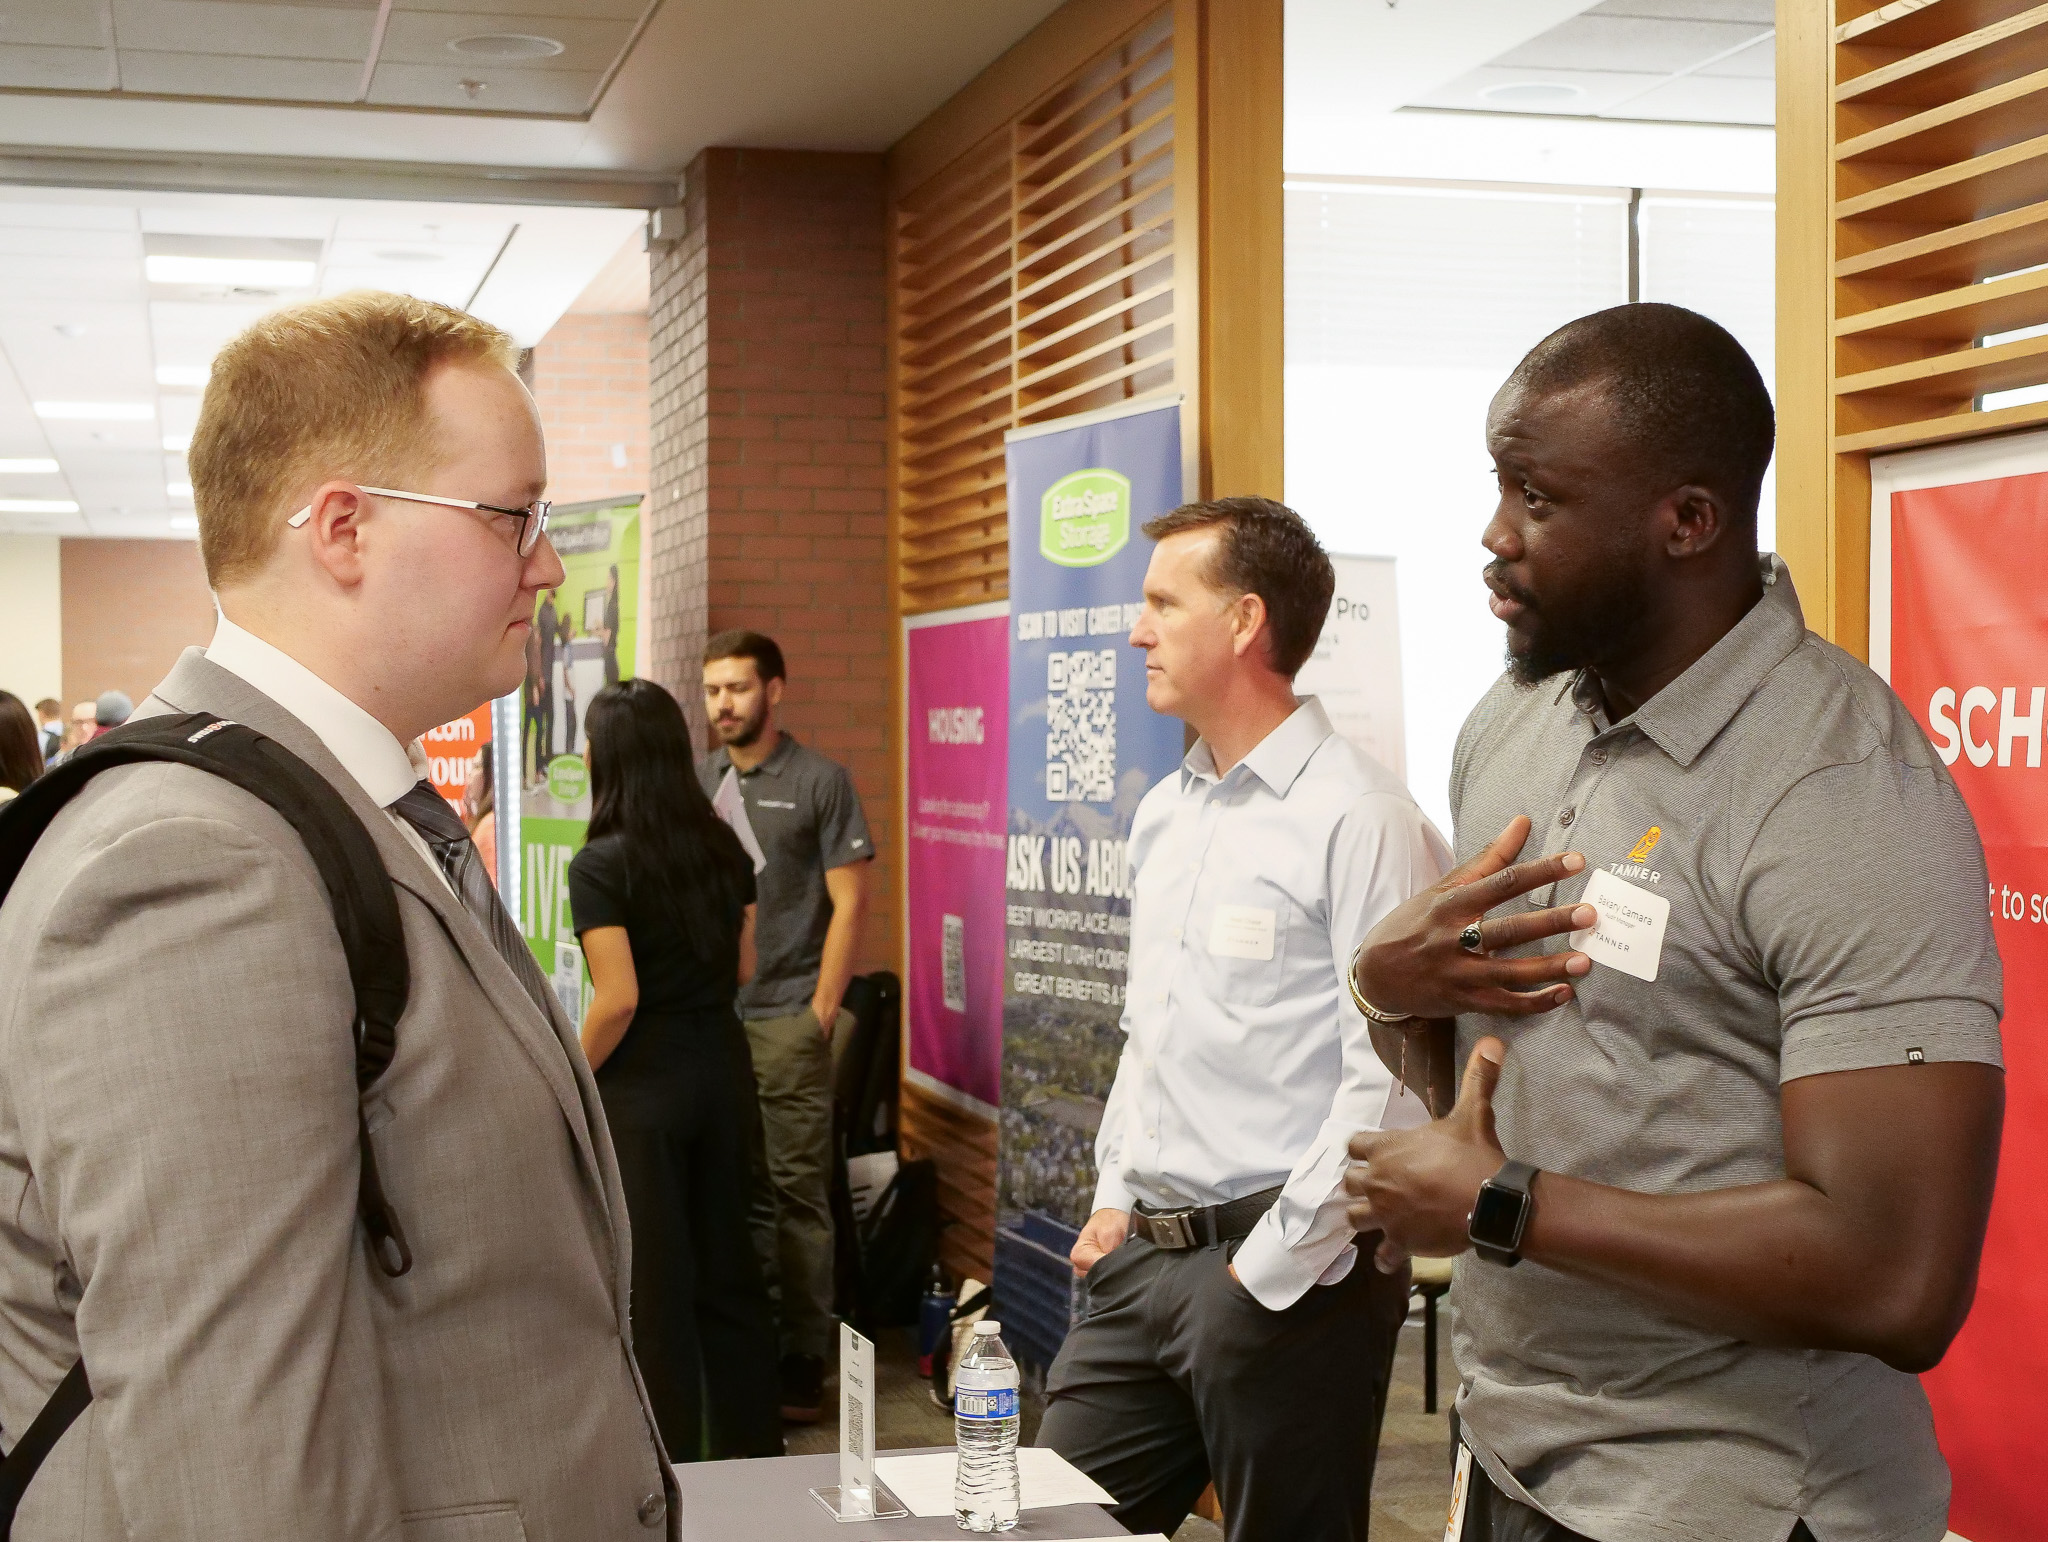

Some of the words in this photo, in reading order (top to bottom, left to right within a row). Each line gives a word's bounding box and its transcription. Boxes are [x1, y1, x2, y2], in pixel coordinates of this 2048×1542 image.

[1336, 597, 1370, 621] Pro
[928, 706, 985, 745] HOUSING
[1928, 686, 2048, 768] SCH
[1005, 834, 1046, 892] ASK
[1051, 836, 1082, 894] US
[1609, 863, 1661, 883] TANNER
[1598, 894, 1621, 913] Bakary
[1621, 906, 1653, 926] Camara
[2001, 885, 2025, 921] to
[1032, 907, 1109, 935] WORKPLACE
[1595, 931, 1630, 953] TANNER
[1013, 971, 1056, 995] GREAT
[1055, 976, 1111, 1004] BENEFITS
